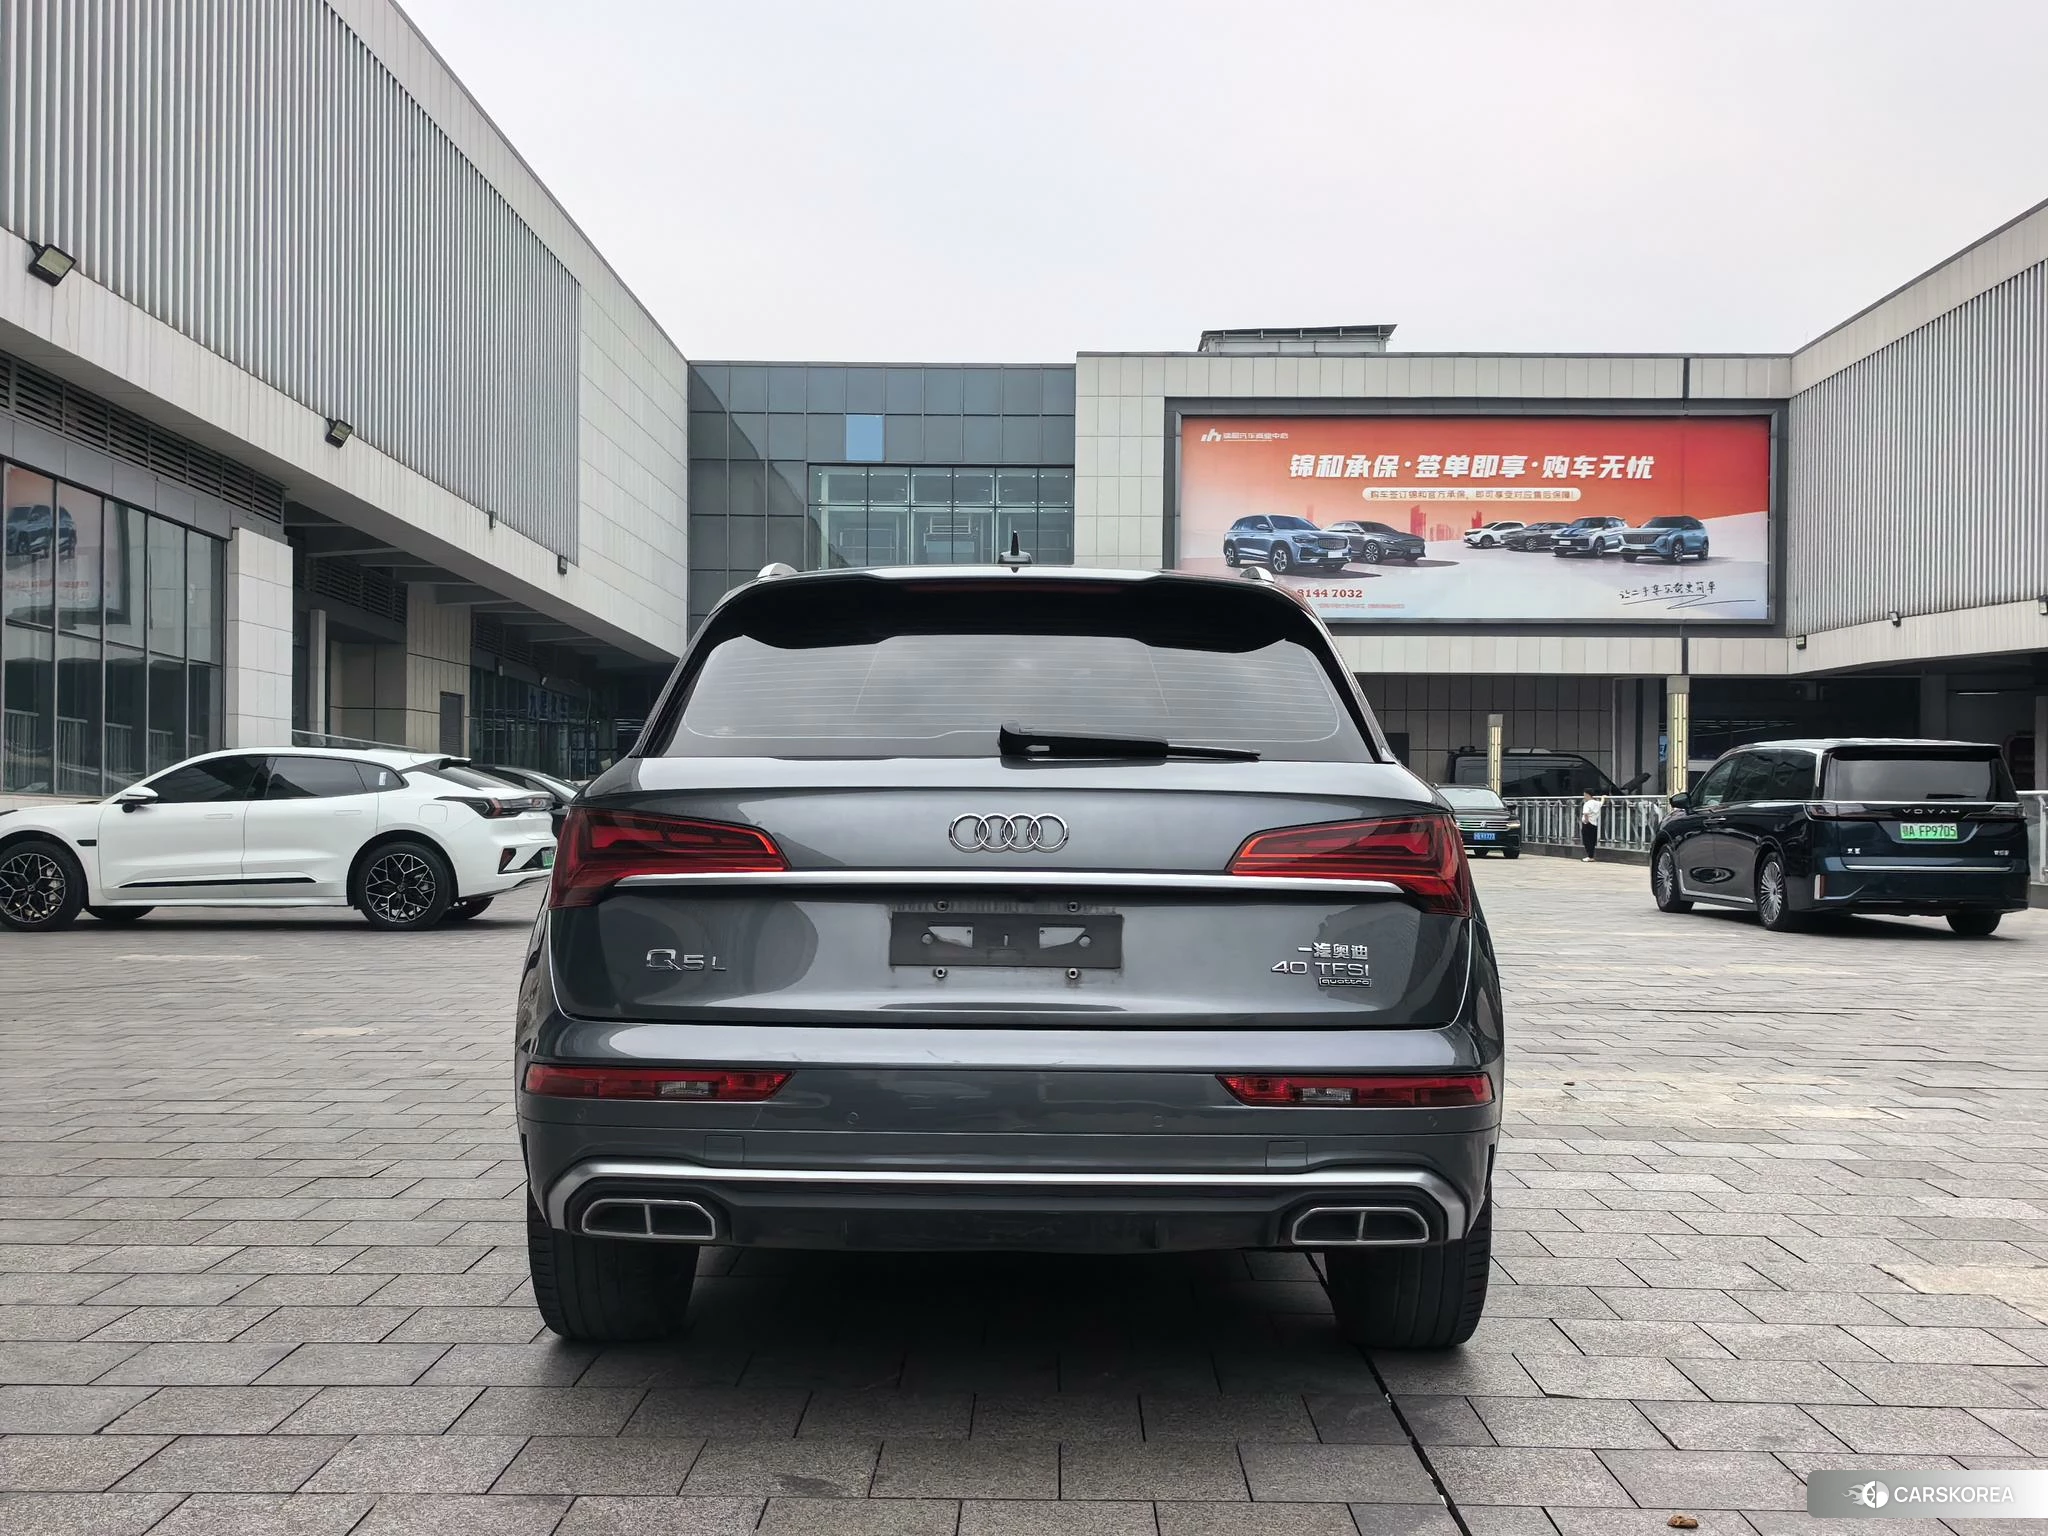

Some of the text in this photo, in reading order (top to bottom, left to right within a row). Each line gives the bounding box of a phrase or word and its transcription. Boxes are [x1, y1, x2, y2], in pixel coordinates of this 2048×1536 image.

[1289, 454, 1655, 478] 锦和承保·签单即享·购车无忧
[1331, 588, 1363, 598] 7032
[1297, 941, 1369, 960] 一汽奥迪
[1270, 960, 1369, 977] 40 TFSI
[1321, 978, 1371, 987] quattro
